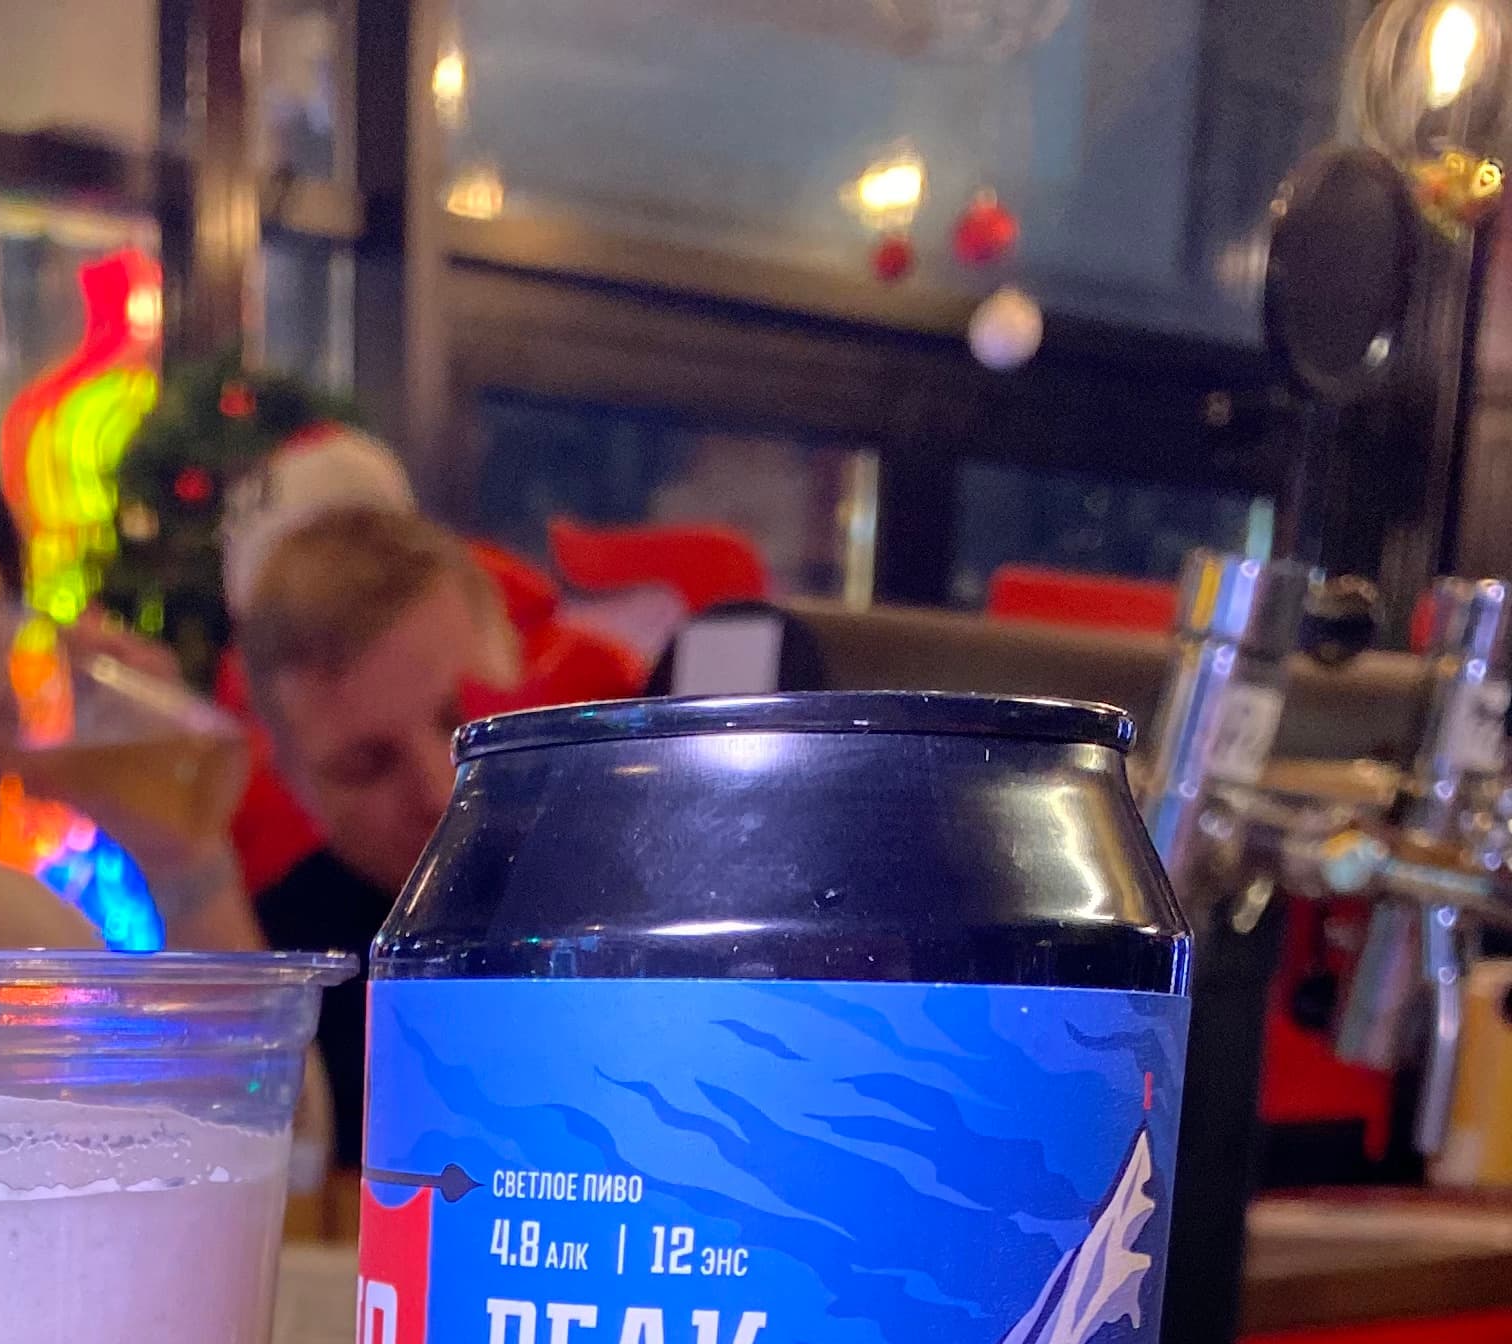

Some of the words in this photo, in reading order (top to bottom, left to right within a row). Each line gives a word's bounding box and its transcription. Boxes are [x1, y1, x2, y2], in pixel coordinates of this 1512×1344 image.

[492, 1169, 579, 1201] СВЕТЛОЕ
[583, 1173, 643, 1203] ПИВО
[489, 1218, 541, 1268] 4.8
[544, 1241, 589, 1270] АЛК
[650, 1225, 695, 1275] 12
[699, 1247, 749, 1277] ЭНС
